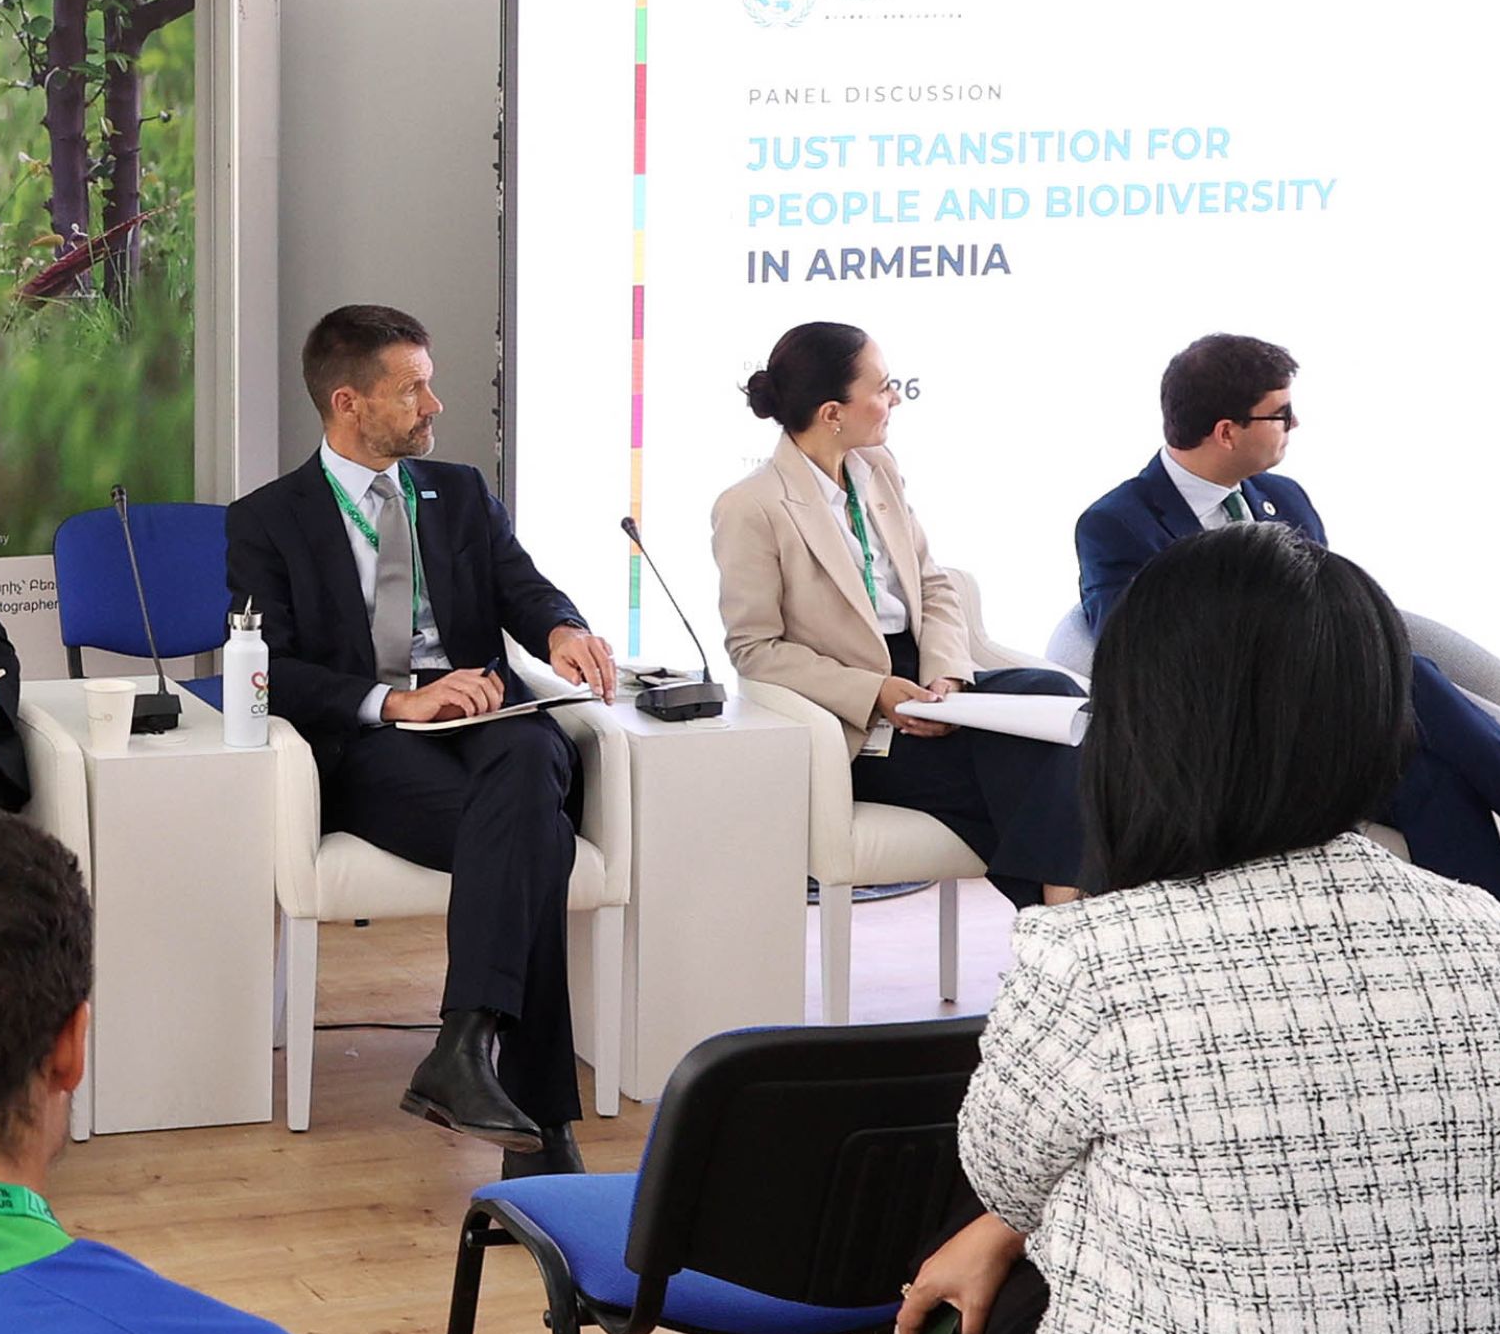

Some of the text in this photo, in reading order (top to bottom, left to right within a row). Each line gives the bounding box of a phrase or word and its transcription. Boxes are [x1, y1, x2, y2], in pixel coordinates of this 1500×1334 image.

[749, 84, 1002, 105] PANEL DISCUSSION
[746, 127, 1231, 171] JUST TRANSITION FOR
[748, 178, 1337, 227] PEOPLE AND BIODIVERSITY
[747, 243, 1012, 284] IN ARMENIA
